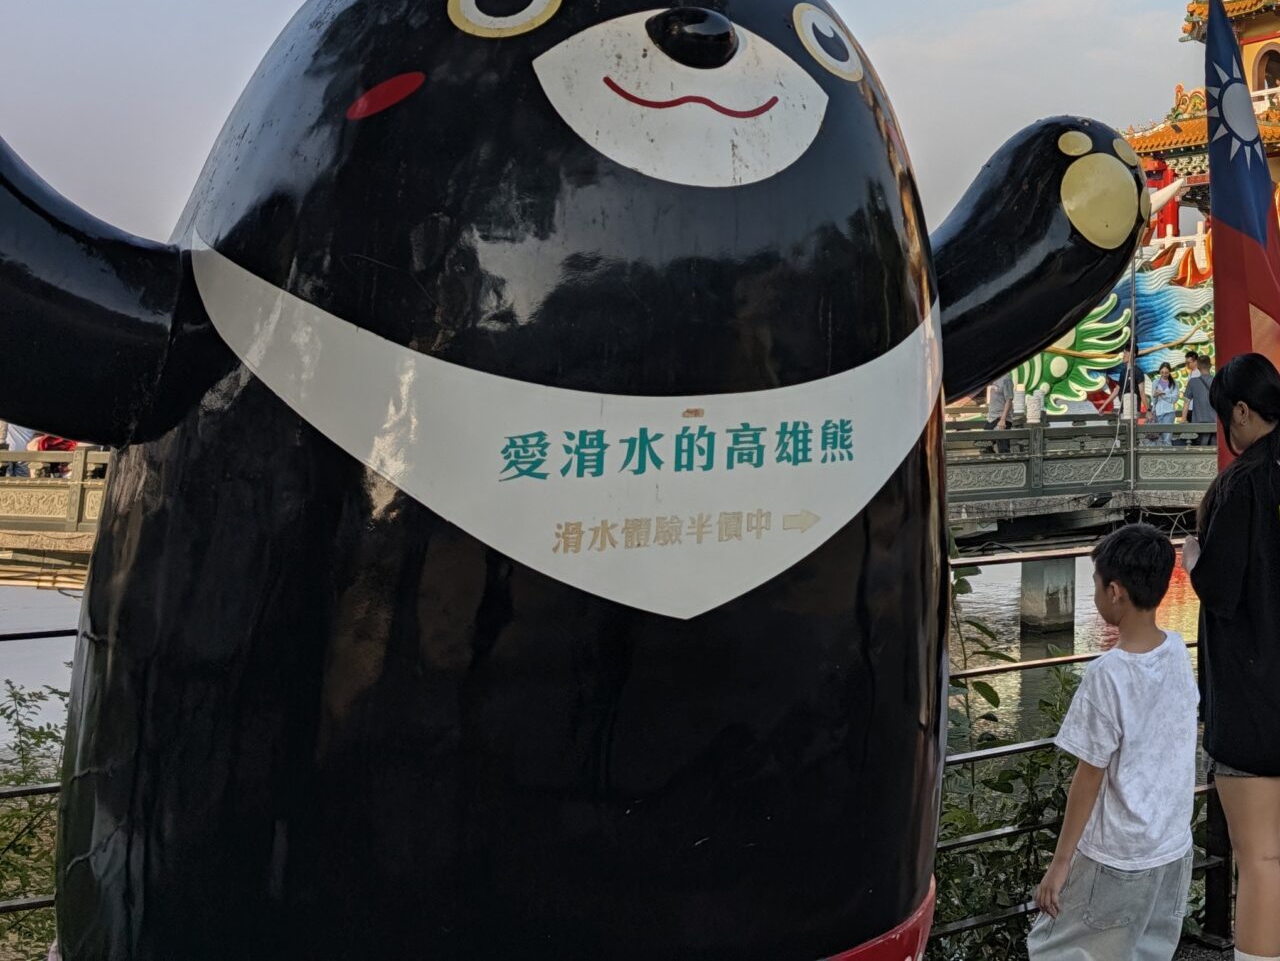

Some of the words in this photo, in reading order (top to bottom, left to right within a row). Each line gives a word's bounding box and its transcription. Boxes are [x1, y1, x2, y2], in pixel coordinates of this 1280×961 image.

[499, 418, 854, 482] 愛滑水的高雄熊
[552, 509, 771, 554] 滑水體驗半價中
